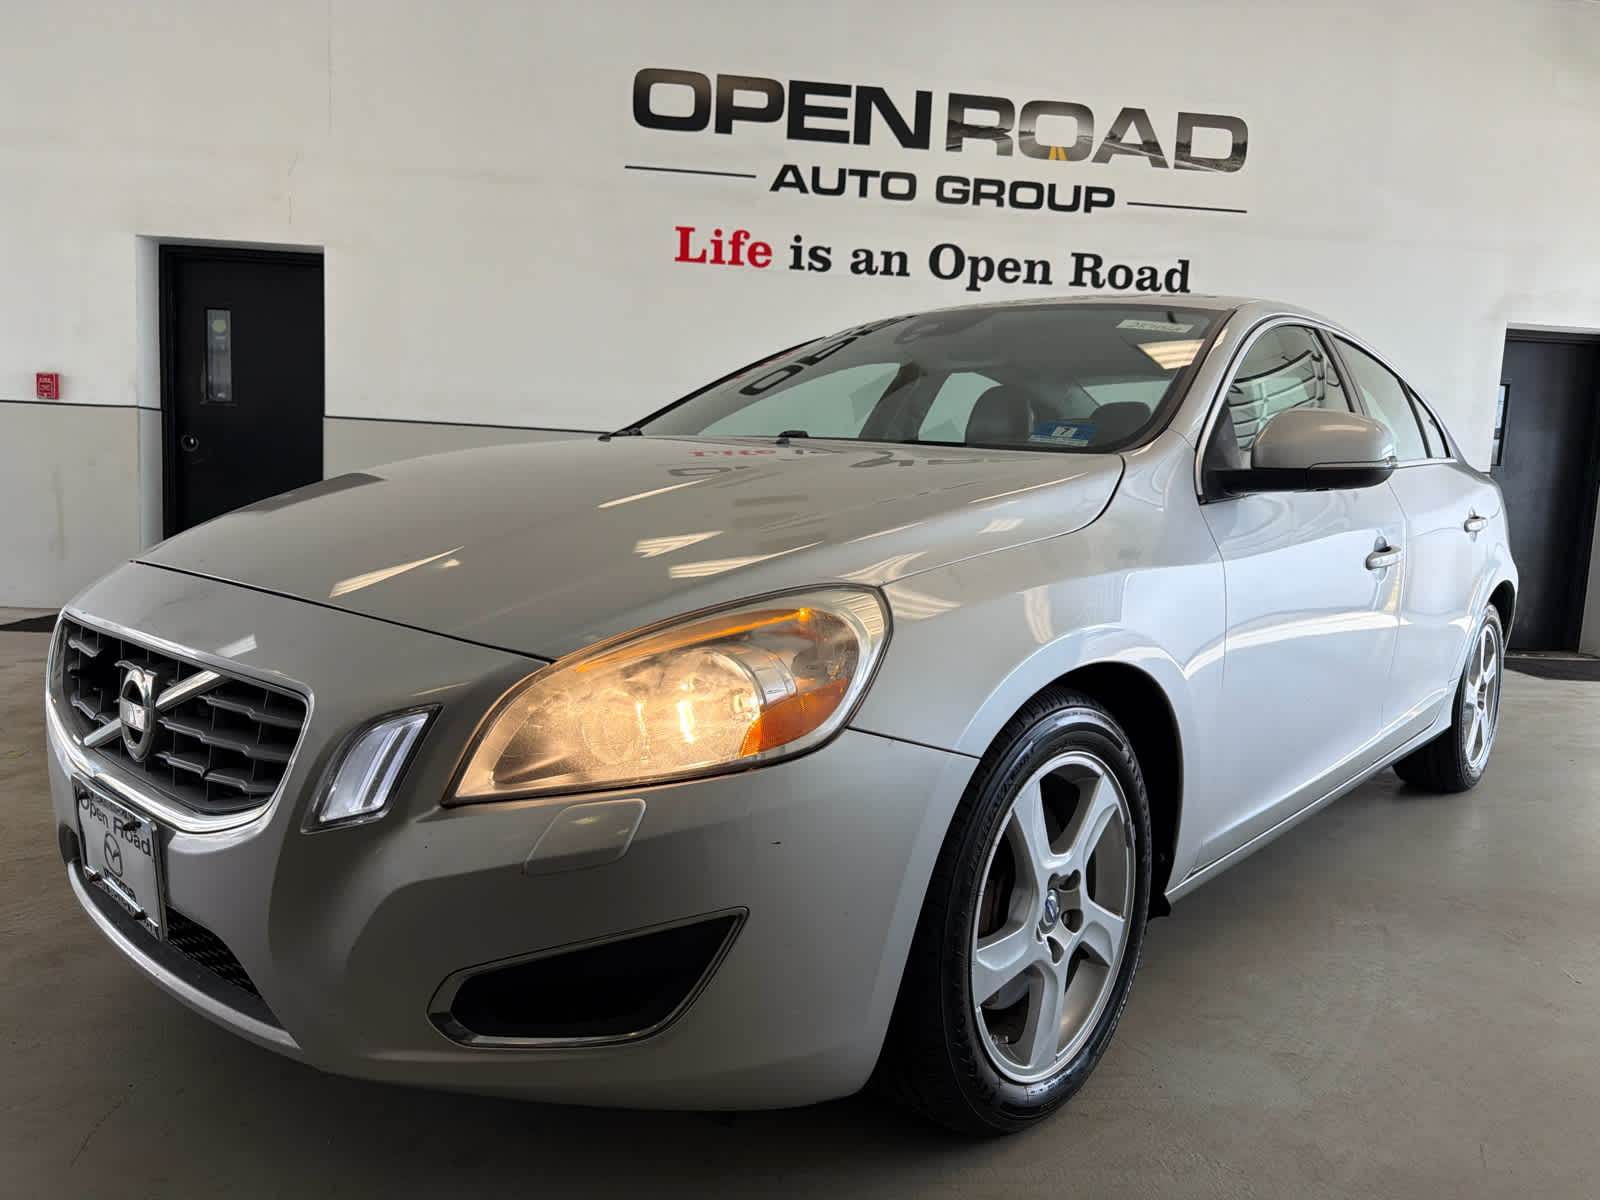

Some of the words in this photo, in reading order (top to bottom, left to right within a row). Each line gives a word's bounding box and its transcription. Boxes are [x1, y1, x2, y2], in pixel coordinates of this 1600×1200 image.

[633, 68, 933, 151] OPEN
[946, 92, 1249, 173] ROAD
[769, 164, 917, 202] AUTO
[935, 175, 1116, 214] GROUP
[674, 225, 773, 268] Life
[789, 234, 832, 273] is
[849, 248, 911, 279] an
[928, 243, 1053, 292] Open
[1068, 252, 1191, 294] Road
[79, 797, 110, 829] Open
[113, 816, 152, 857] Road
